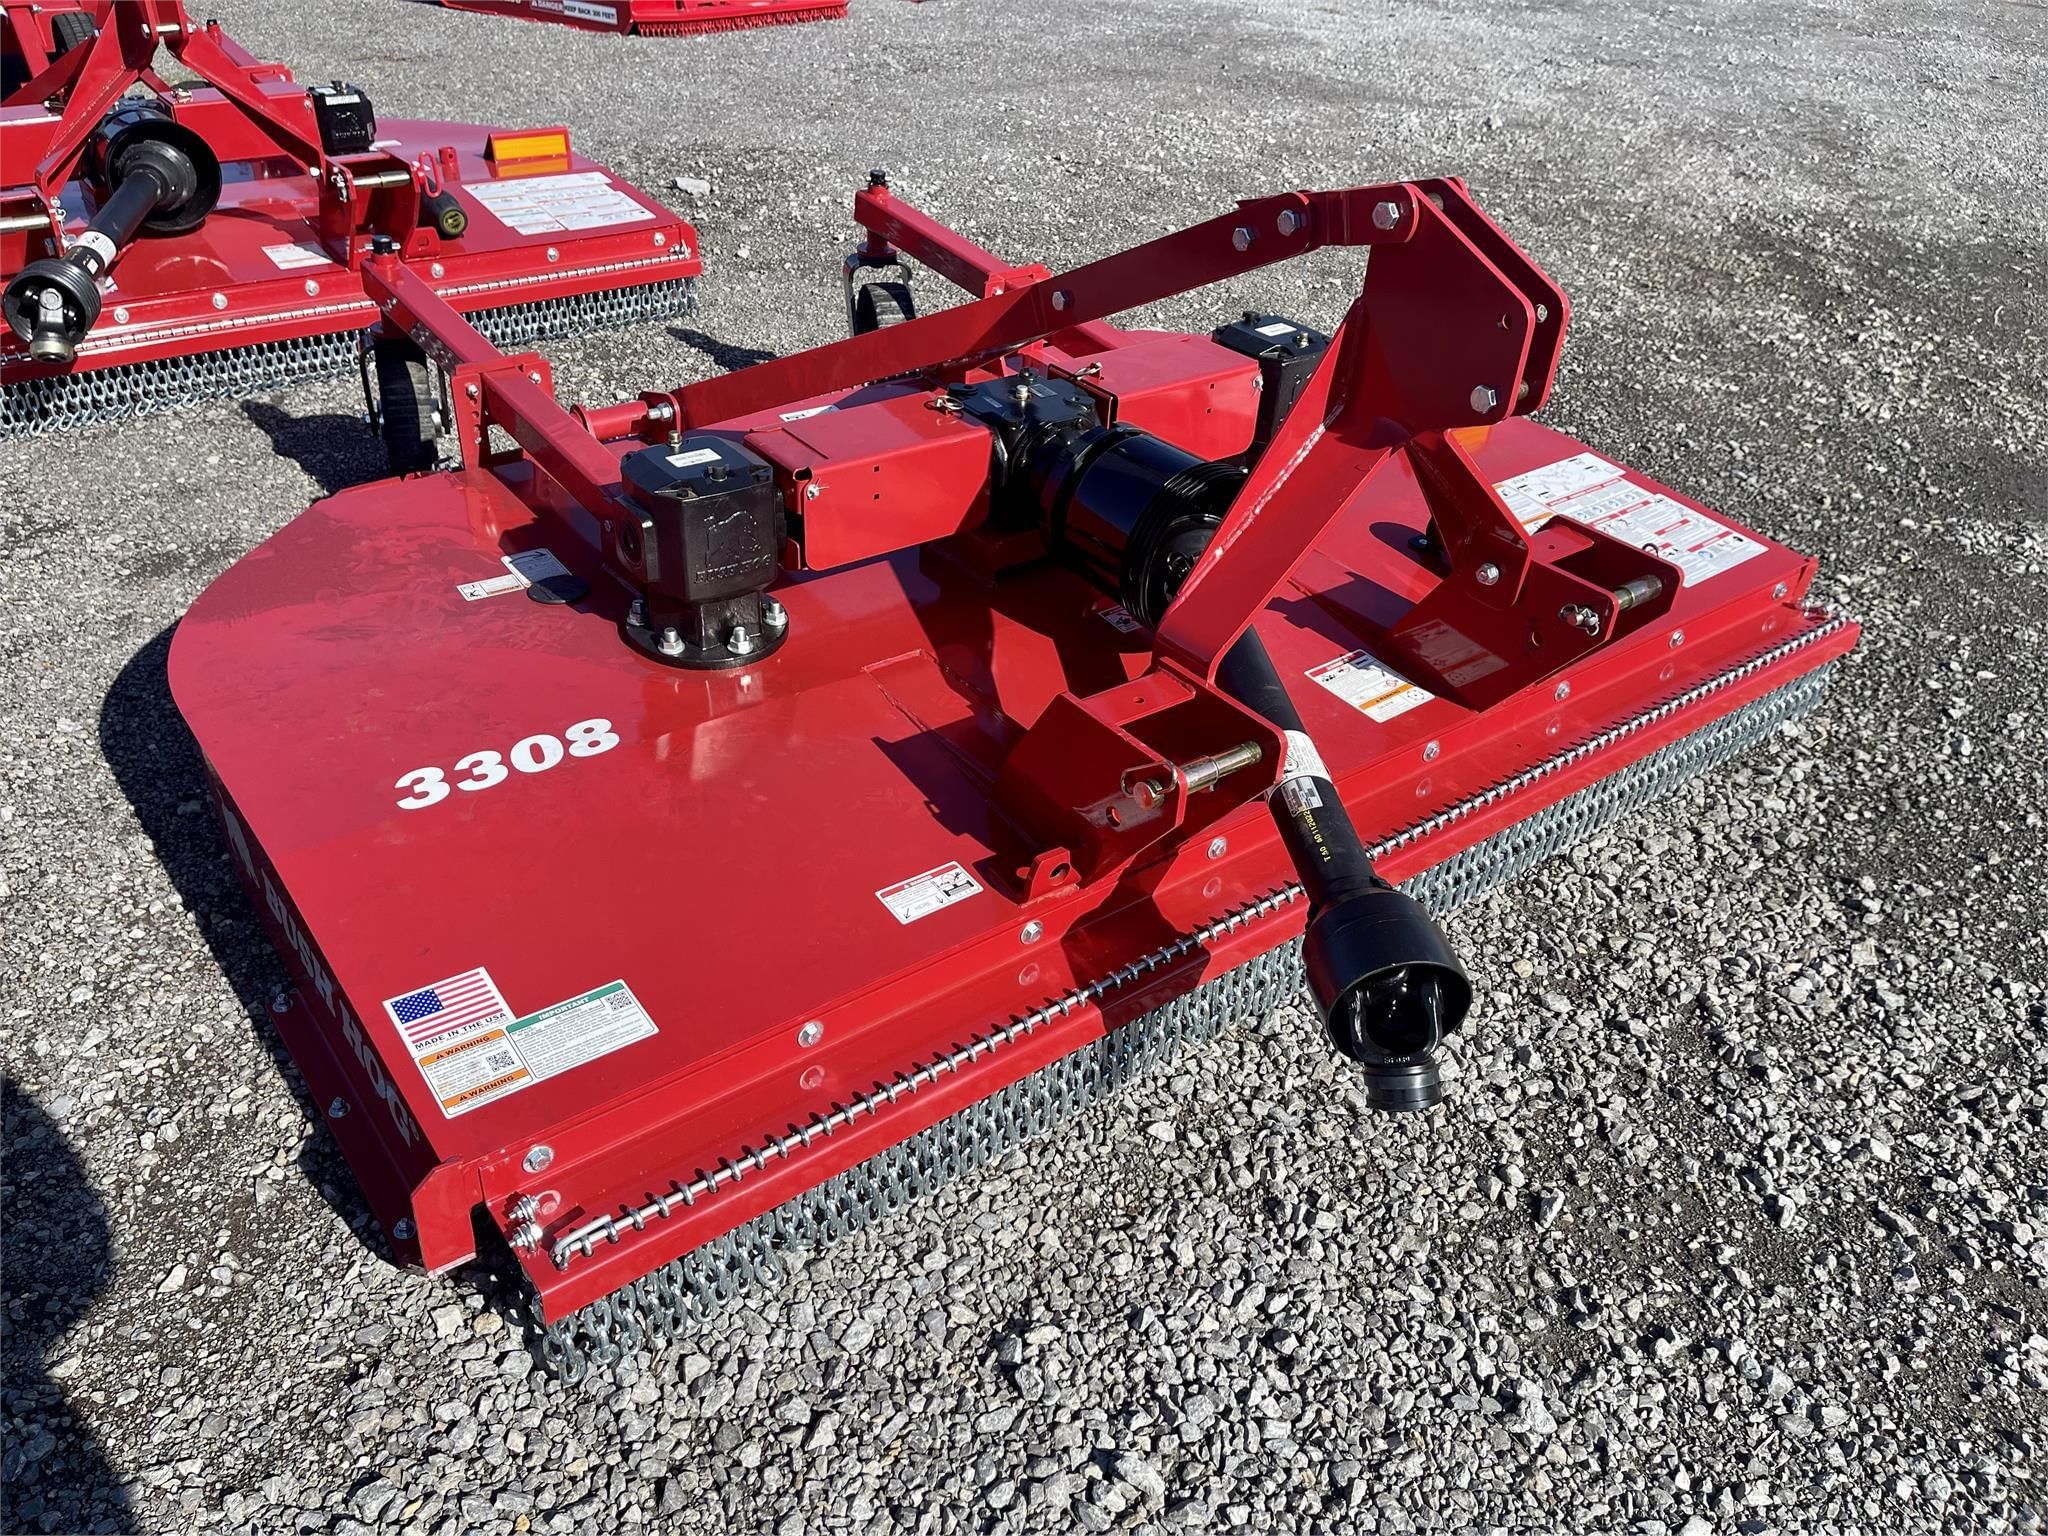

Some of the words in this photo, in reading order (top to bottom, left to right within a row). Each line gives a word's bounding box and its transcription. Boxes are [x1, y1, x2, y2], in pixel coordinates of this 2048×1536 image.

[577, 6, 591, 16] BACK
[394, 718, 621, 810] 3308
[261, 868, 337, 1018] BUSH
[538, 996, 590, 1020] IMPORTANT
[415, 1034, 445, 1050] MADE
[447, 1030, 460, 1038] IN
[461, 1021, 484, 1032] THE
[485, 1012, 507, 1023] USA
[445, 1035, 491, 1056] WARNING
[468, 1075, 515, 1097] WARNING
